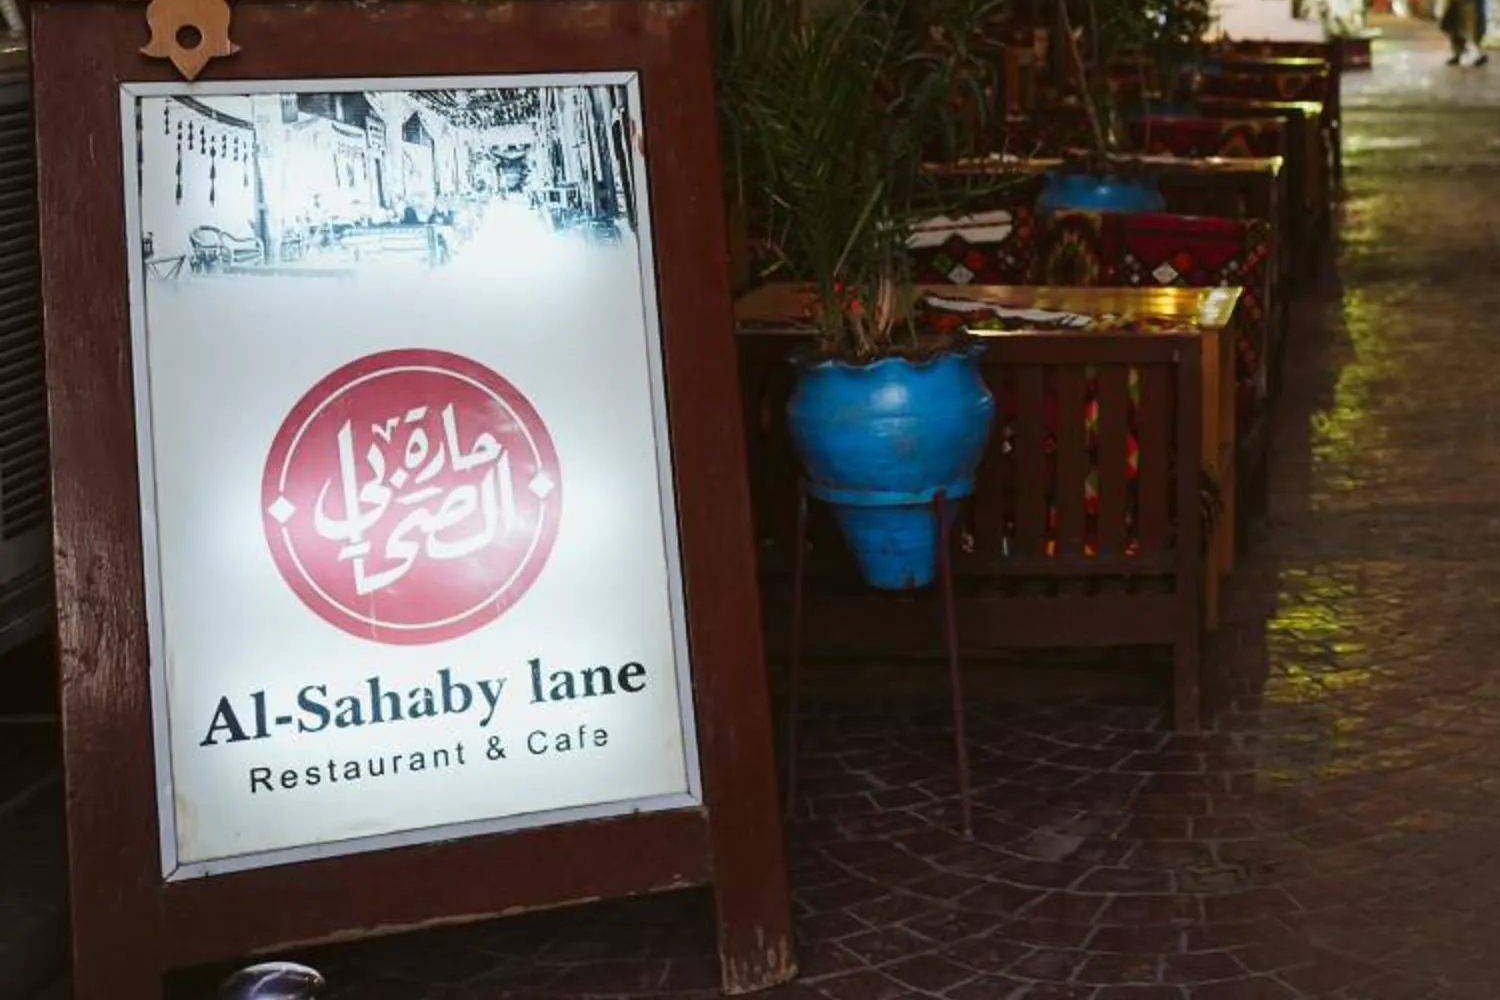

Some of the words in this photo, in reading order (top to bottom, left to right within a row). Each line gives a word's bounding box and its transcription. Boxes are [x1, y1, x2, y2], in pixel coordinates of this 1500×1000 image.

[200, 668, 508, 747] Al-Sahaby
[528, 658, 648, 704] lane
[249, 741, 466, 793] Restaurant
[485, 735, 507, 760] &
[527, 725, 610, 756] Cafe
